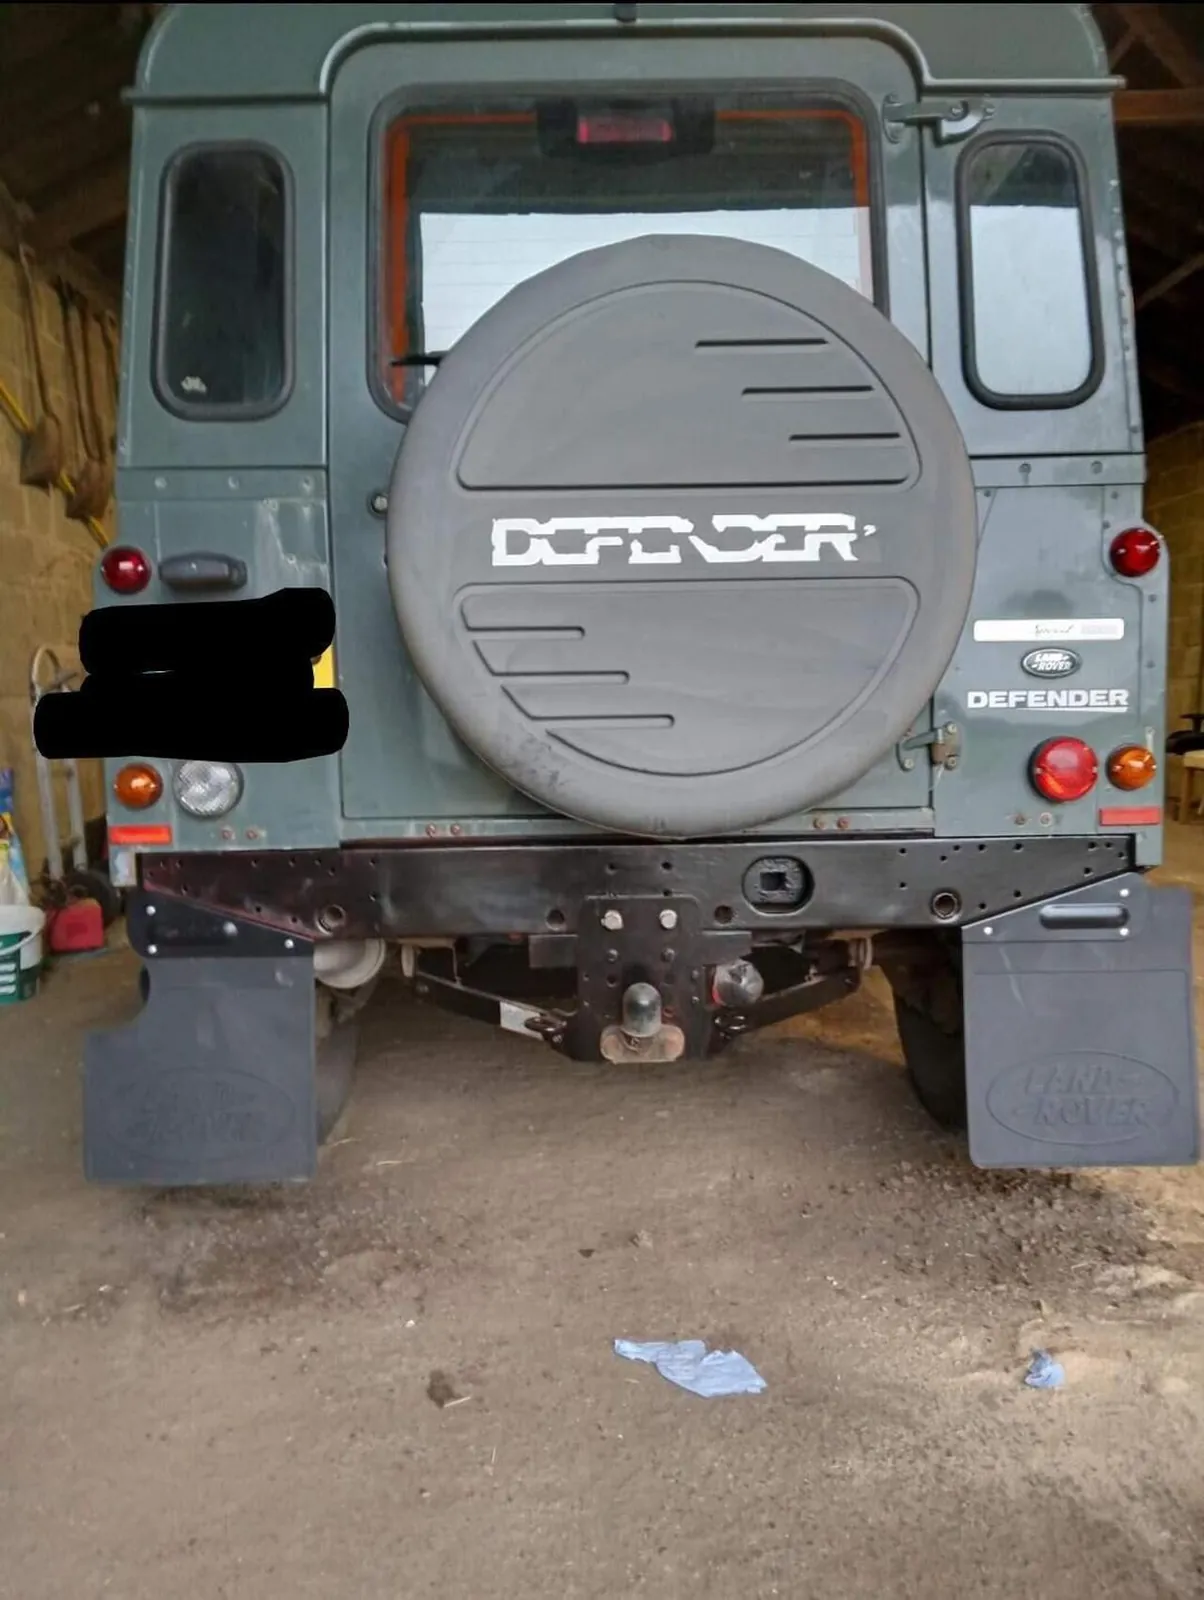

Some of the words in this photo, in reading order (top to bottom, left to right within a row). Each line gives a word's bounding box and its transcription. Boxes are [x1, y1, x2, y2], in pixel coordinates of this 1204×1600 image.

[1037, 660, 1072, 671] ROVER
[967, 689, 1129, 709] DEFENDER
[1033, 1096, 1151, 1127] ROVER
